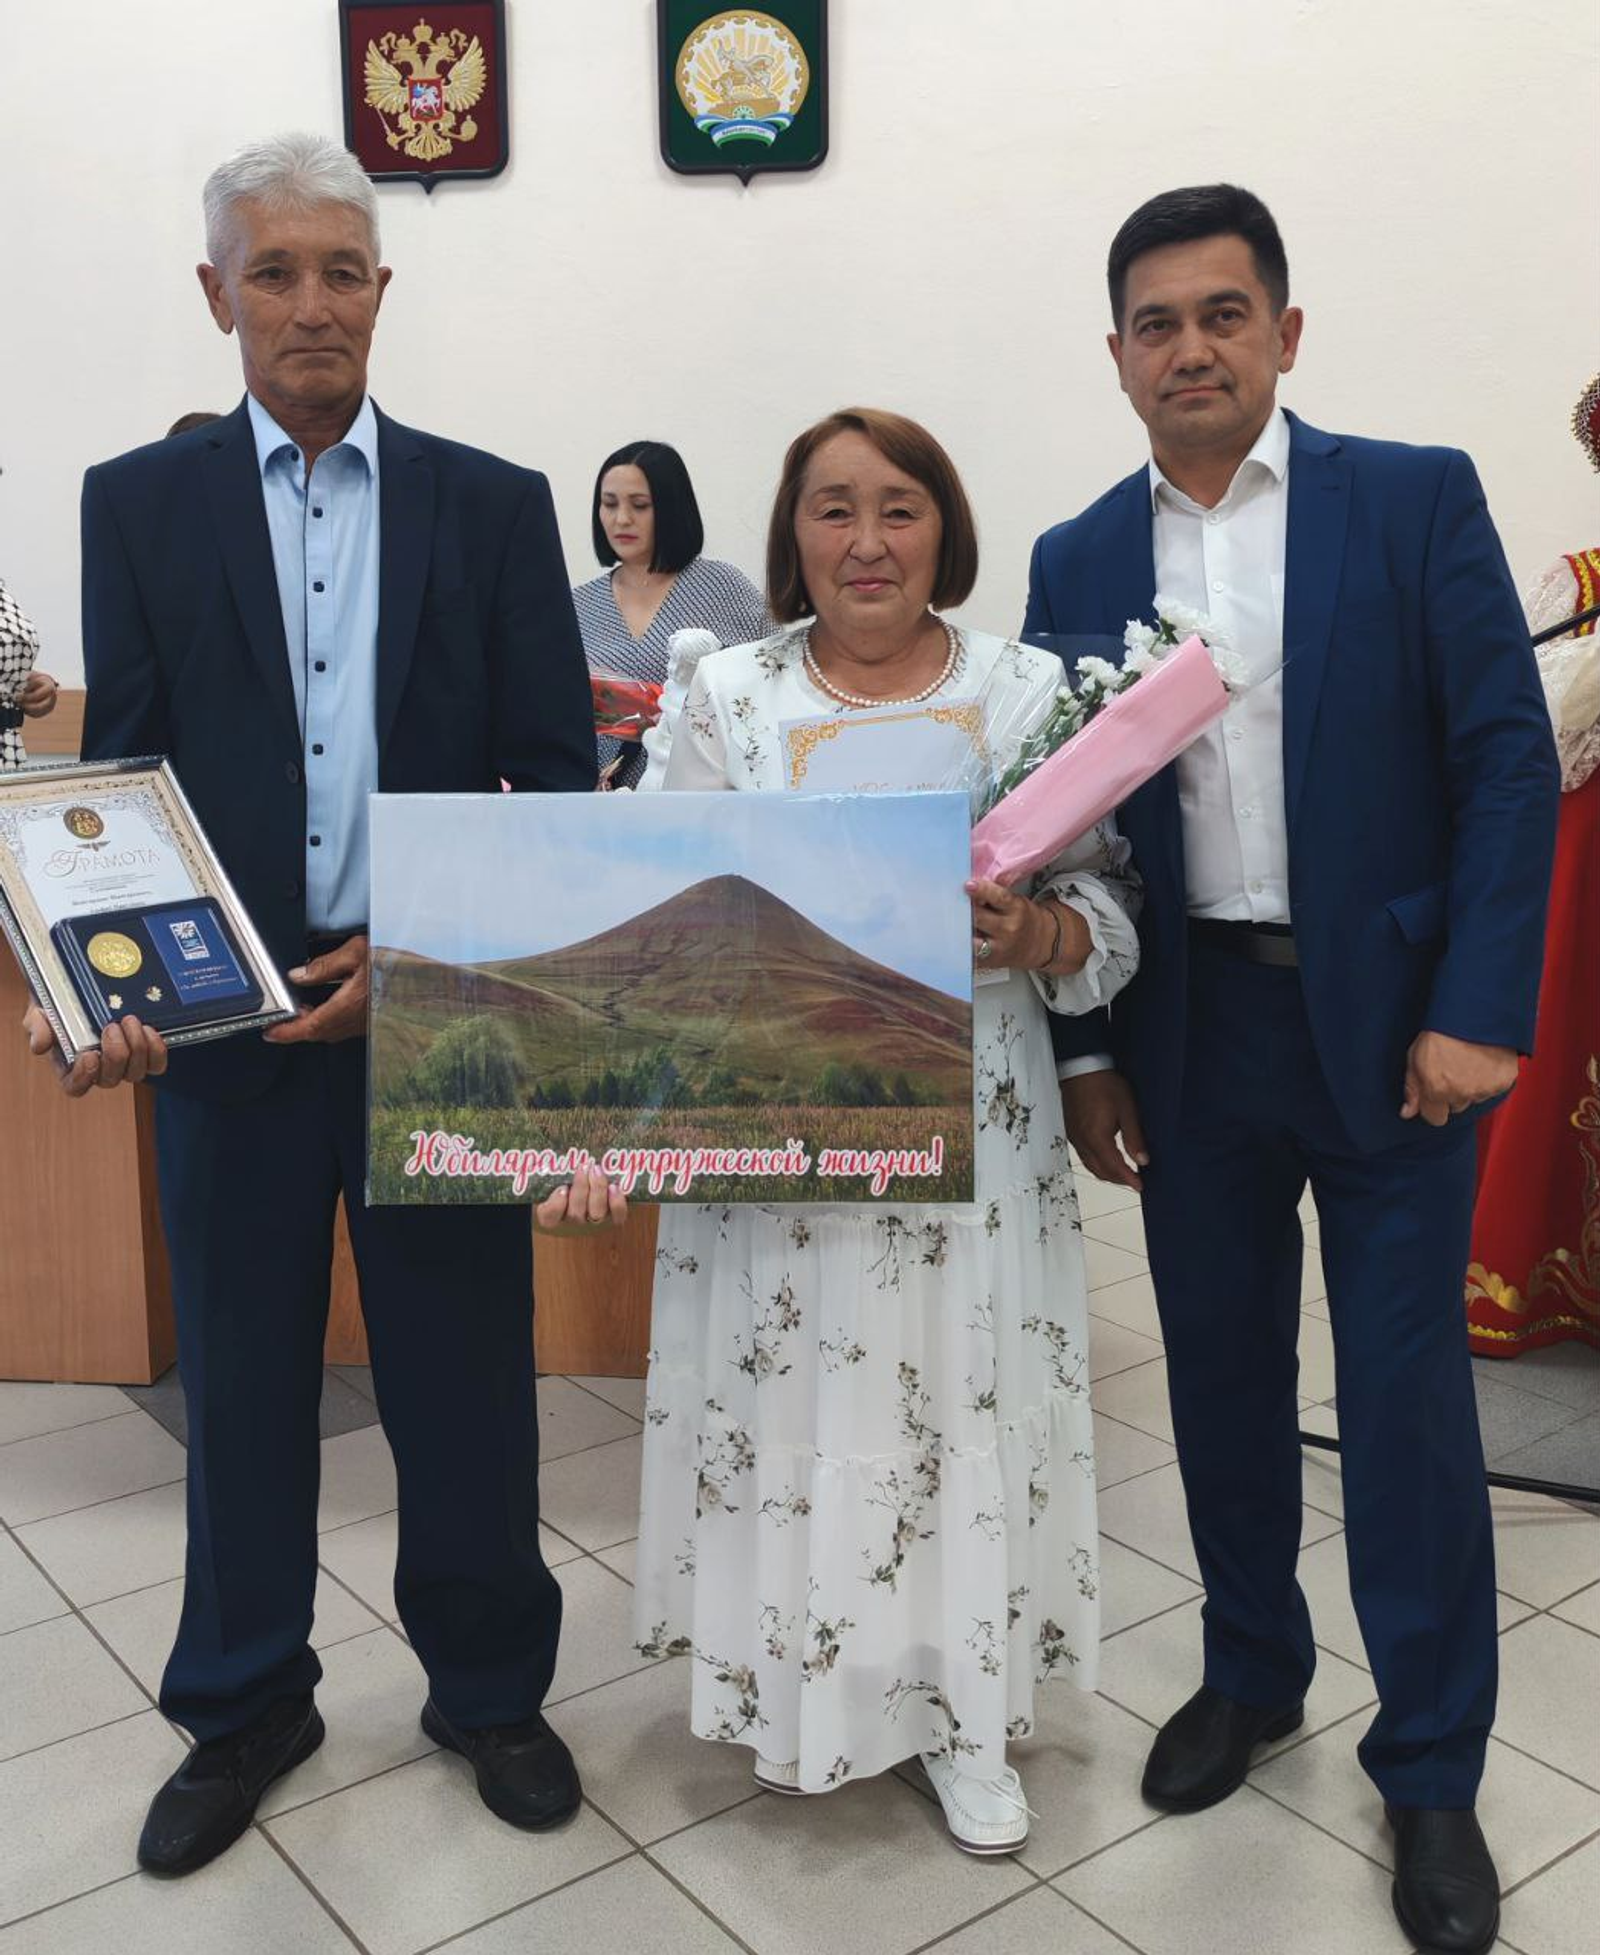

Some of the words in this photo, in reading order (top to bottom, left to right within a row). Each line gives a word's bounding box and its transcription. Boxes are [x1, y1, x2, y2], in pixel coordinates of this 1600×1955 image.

[405, 1131, 592, 1196] Юбилярам
[602, 1138, 812, 1196] супружеской
[816, 1136, 944, 1197] жизни!
